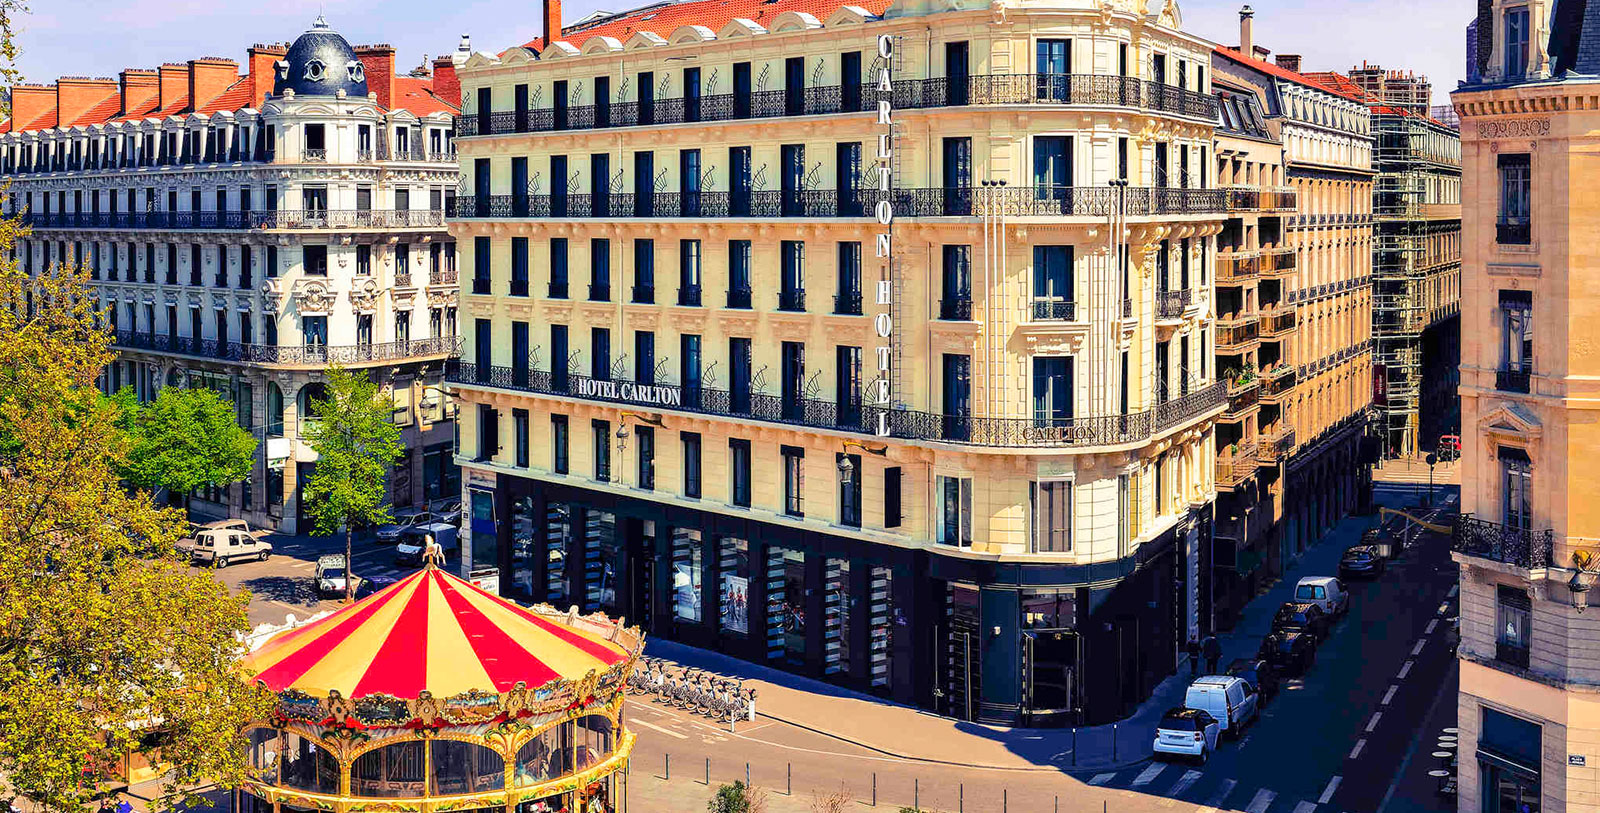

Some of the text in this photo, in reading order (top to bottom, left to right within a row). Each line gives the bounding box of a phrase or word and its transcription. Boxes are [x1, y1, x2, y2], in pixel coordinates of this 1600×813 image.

[875, 35, 892, 436] CARLTON HOTEL
[578, 378, 681, 406] HOTEL CARLTON
[1022, 427, 1097, 441] CARLTON
